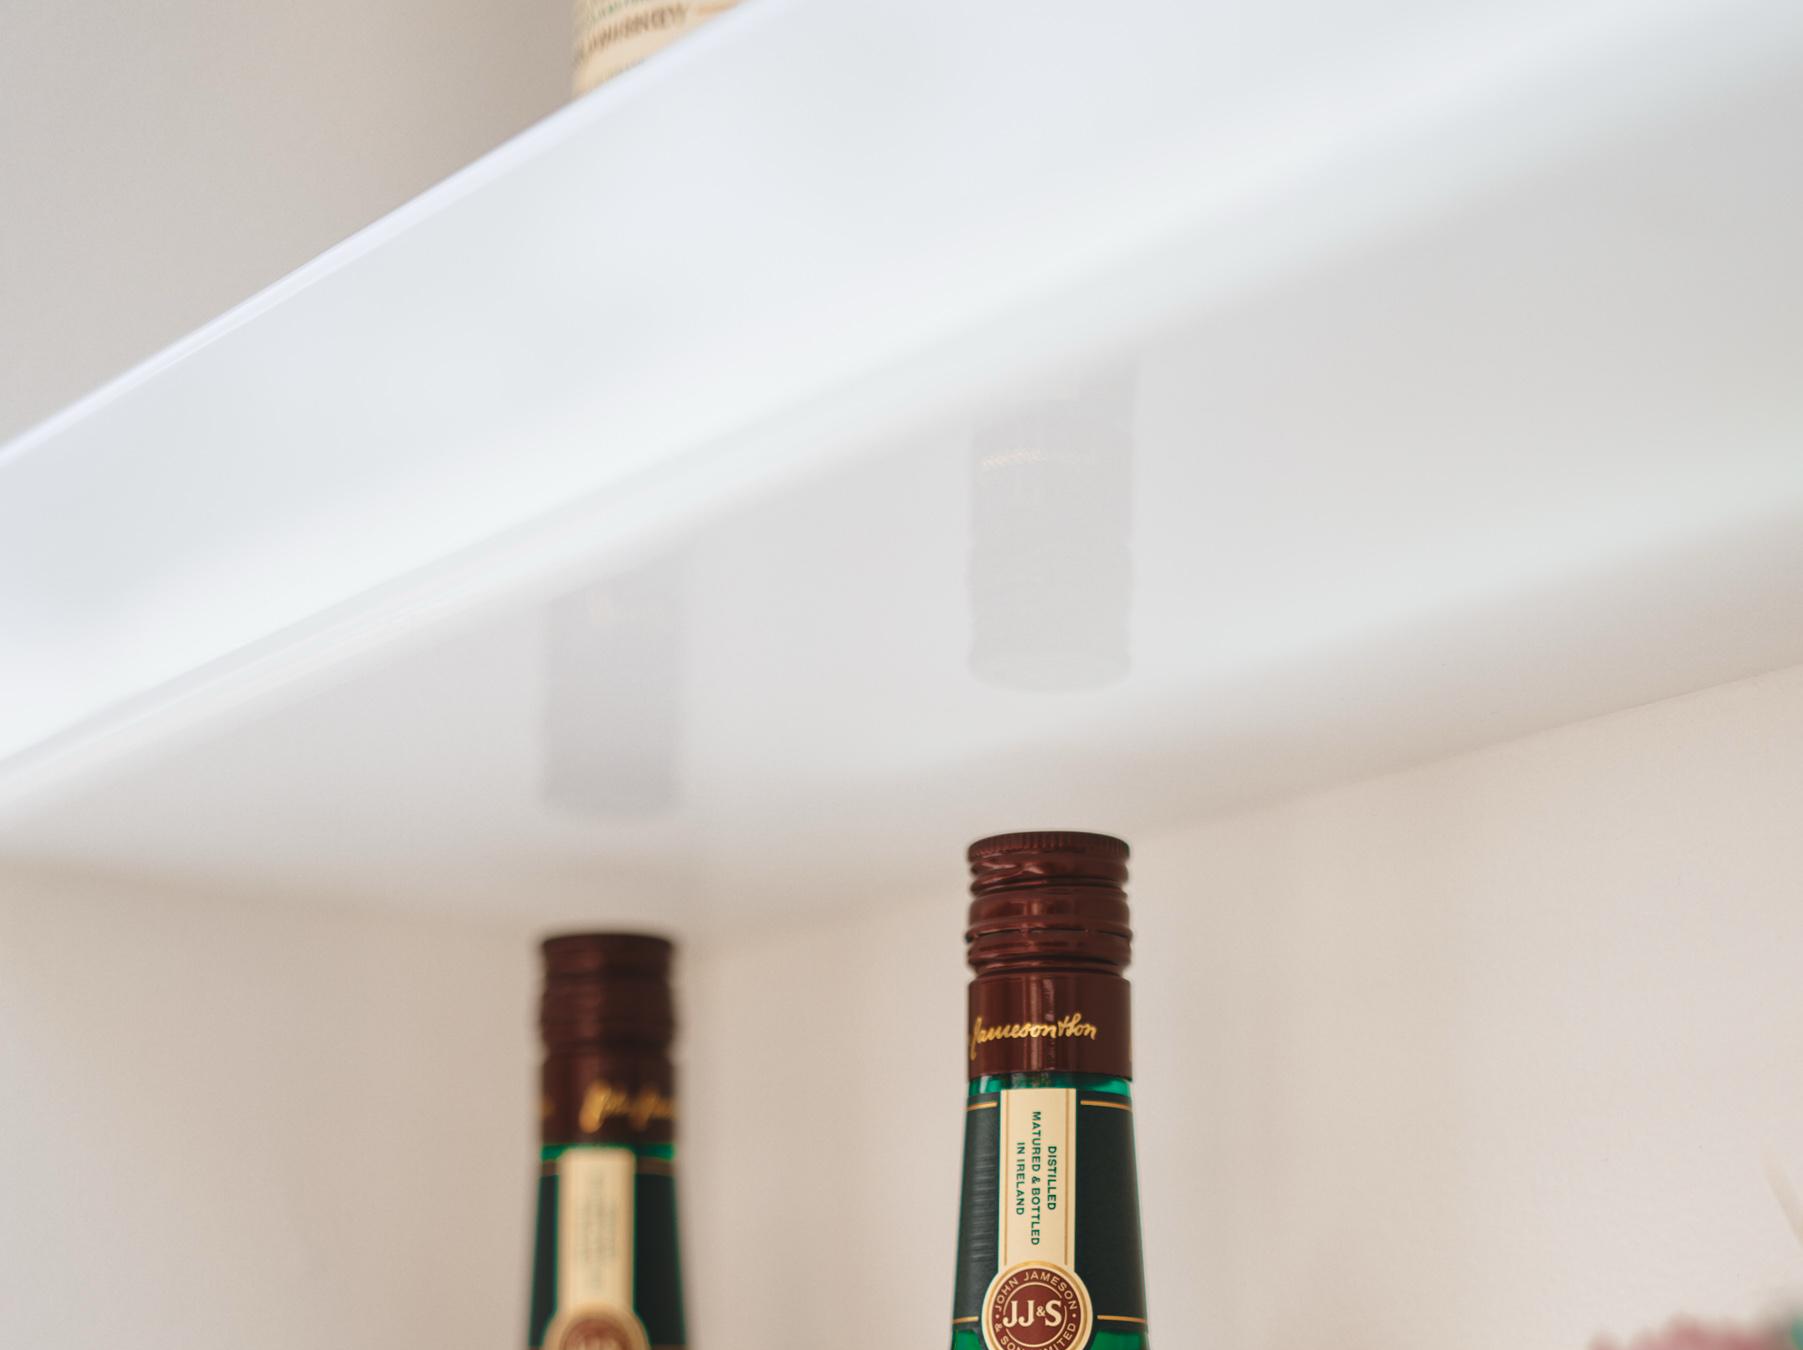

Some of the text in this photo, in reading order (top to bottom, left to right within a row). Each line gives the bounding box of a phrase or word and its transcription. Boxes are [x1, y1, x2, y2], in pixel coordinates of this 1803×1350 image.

[1016, 1142, 1025, 1216] IN IRELAND
[1030, 1111, 1042, 1245] MATURED & BOTTLED
[1048, 1146, 1057, 1210] DISTILLED
[994, 1270, 1078, 1312] JOHN JAMESON
[1002, 1299, 1062, 1327] JJ&S
